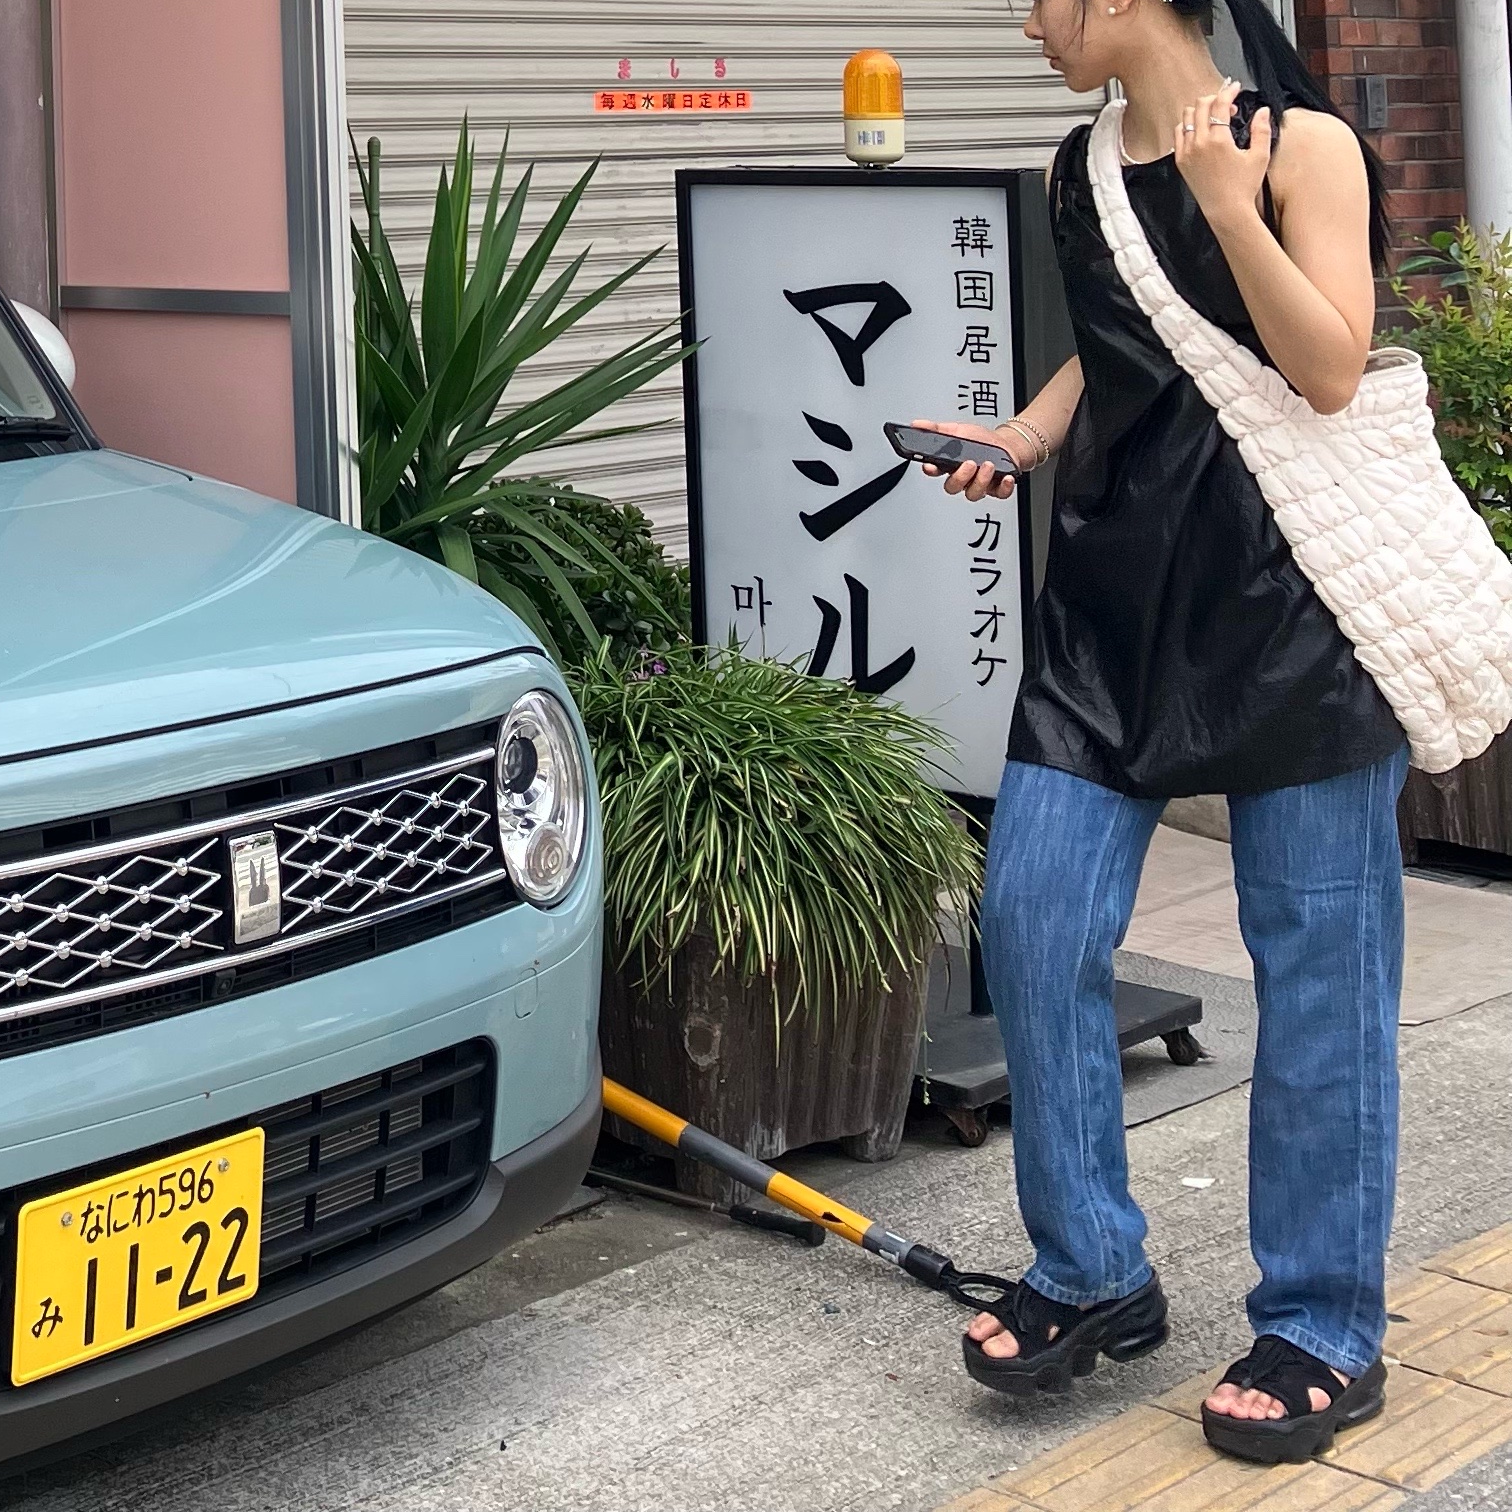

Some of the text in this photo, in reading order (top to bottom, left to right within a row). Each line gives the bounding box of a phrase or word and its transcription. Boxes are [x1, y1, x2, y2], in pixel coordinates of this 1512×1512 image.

[600, 92, 747, 110] 毎週水曜日定休日
[617, 57, 727, 80] ましる
[783, 281, 915, 695] マシル
[951, 216, 1008, 687] 韓国居酒 カラオケ
[32, 1207, 249, 1346] み 11-22
